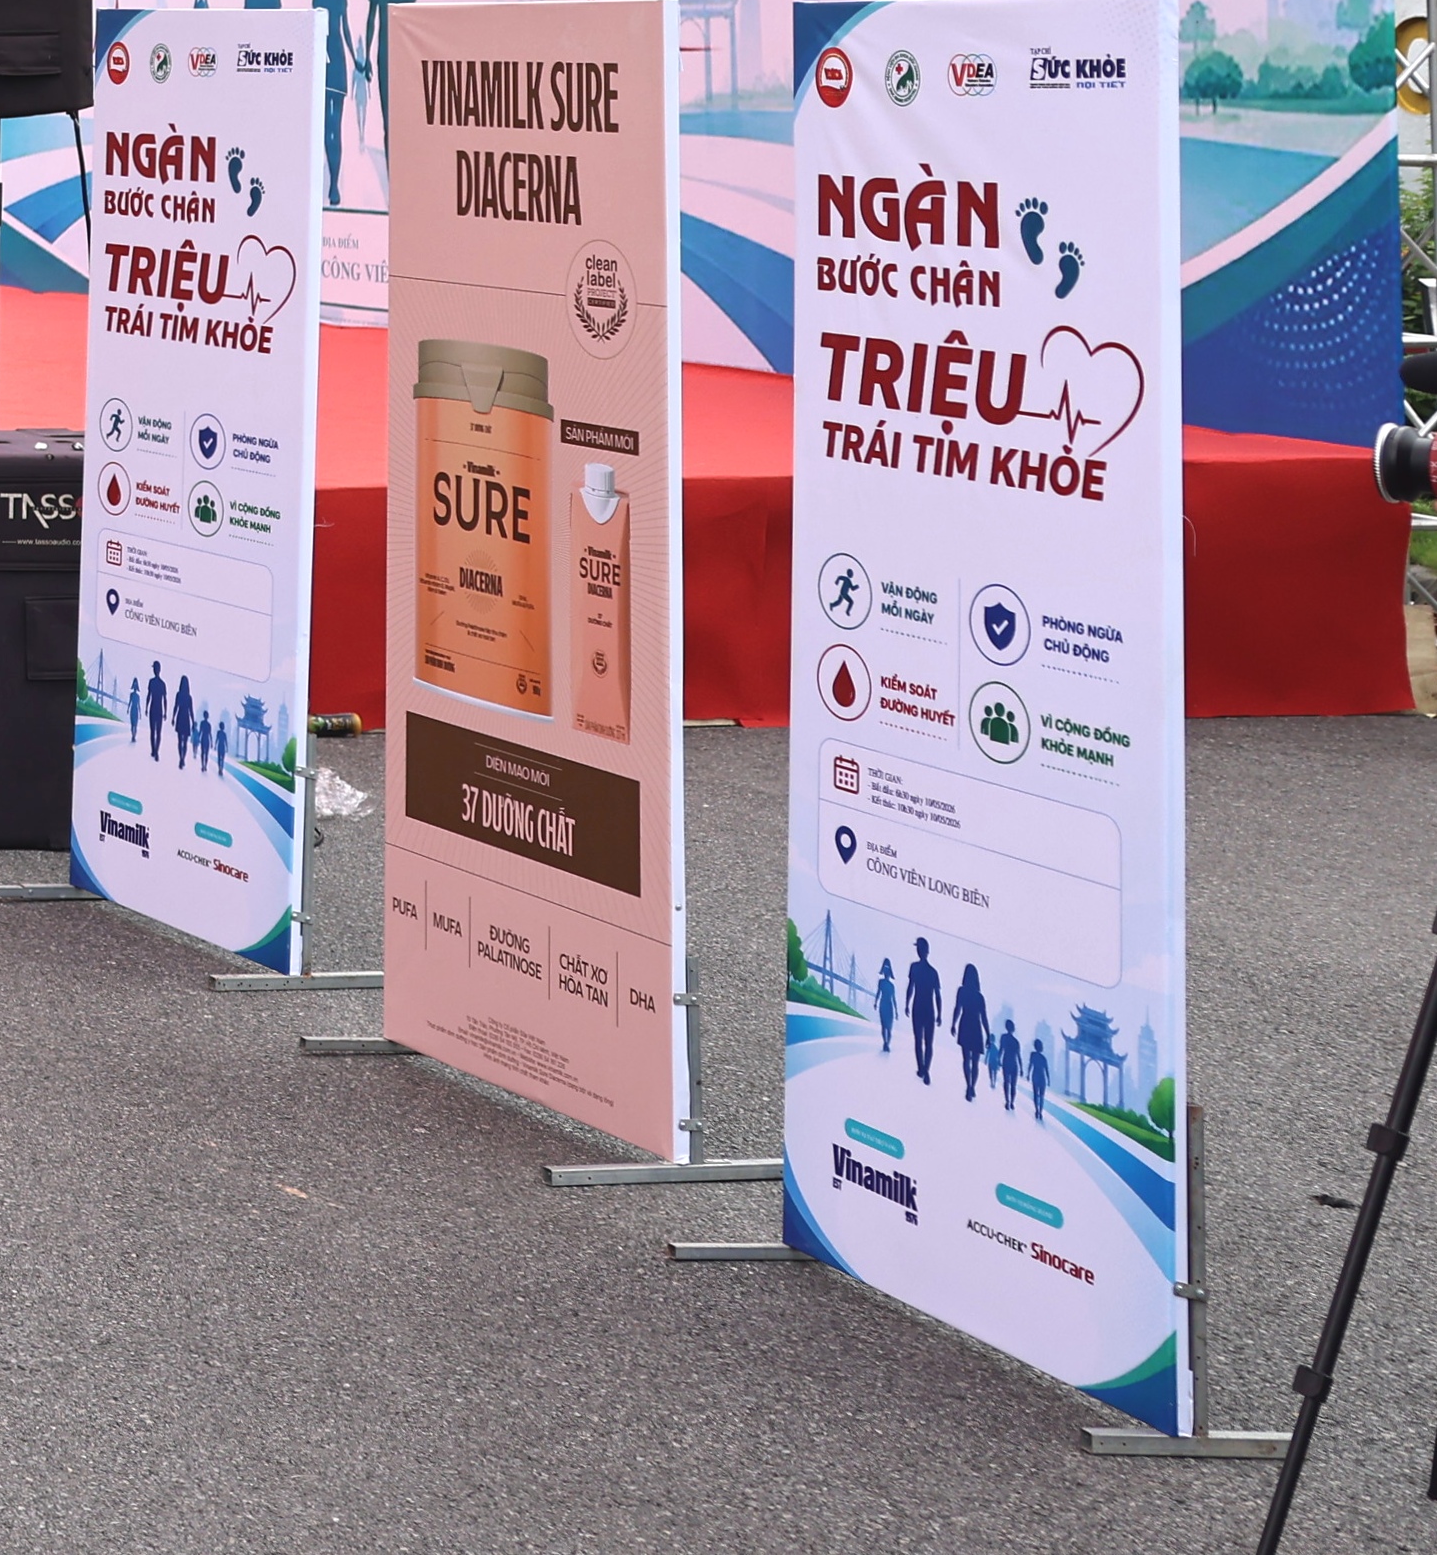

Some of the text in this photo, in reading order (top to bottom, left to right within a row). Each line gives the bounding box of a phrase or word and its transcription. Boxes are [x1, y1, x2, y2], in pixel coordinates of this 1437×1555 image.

[950, 63, 994, 87] VDEA
[421, 59, 619, 133] VINAMILK SURE
[105, 123, 216, 183] NGÀN
[456, 149, 581, 225] DIACERNA
[104, 188, 215, 224] BƯỚC CHÂN
[817, 162, 1000, 251] NGÀN
[105, 240, 229, 313] TRIỆU
[321, 256, 389, 284] CÔNG VIÊ
[585, 254, 617, 272] clean
[587, 270, 615, 288] label
[817, 252, 1001, 309] BƯỚC CHÂN
[105, 304, 273, 354] TRÁI TIM KHỎE
[820, 329, 1027, 435] TRIỆU
[822, 418, 1108, 502] TRÁI TIM KHỎE
[434, 471, 530, 544] SURE
[460, 566, 503, 597] DIACERNA
[579, 557, 621, 586] SURE
[881, 580, 938, 606] VẬN ĐỘNG
[904, 604, 934, 625] NGÀY
[1042, 614, 1124, 644] PHÒNG NGỪA
[1072, 642, 1110, 665] ĐỘNG
[880, 674, 938, 700] KIỂM SOÁT
[879, 695, 956, 727] ĐƯỜNG HUYẾT
[1040, 713, 1053, 729] VÌ
[1055, 718, 1091, 738] CỘNG
[1076, 746, 1114, 767] MẠNH
[530, 767, 550, 787] MỚI
[100, 810, 150, 849] Vinamilk
[461, 783, 576, 857] 37 DƯỠNG CHẤT
[213, 859, 248, 882] Sinocare
[867, 857, 990, 908] CÔNG VIÊN LONG BIÊN
[392, 897, 418, 920] PUFA
[433, 911, 463, 937] MUFA
[489, 924, 531, 954] ĐƯỜNG
[477, 941, 543, 981] PALATINOSE
[559, 952, 609, 984] CHẤT XƠ
[558, 972, 609, 1008] HÒA TAN
[629, 988, 656, 1014] DHA
[832, 1142, 918, 1213] Vinamilk
[1030, 1242, 1094, 1286] Sinocare
